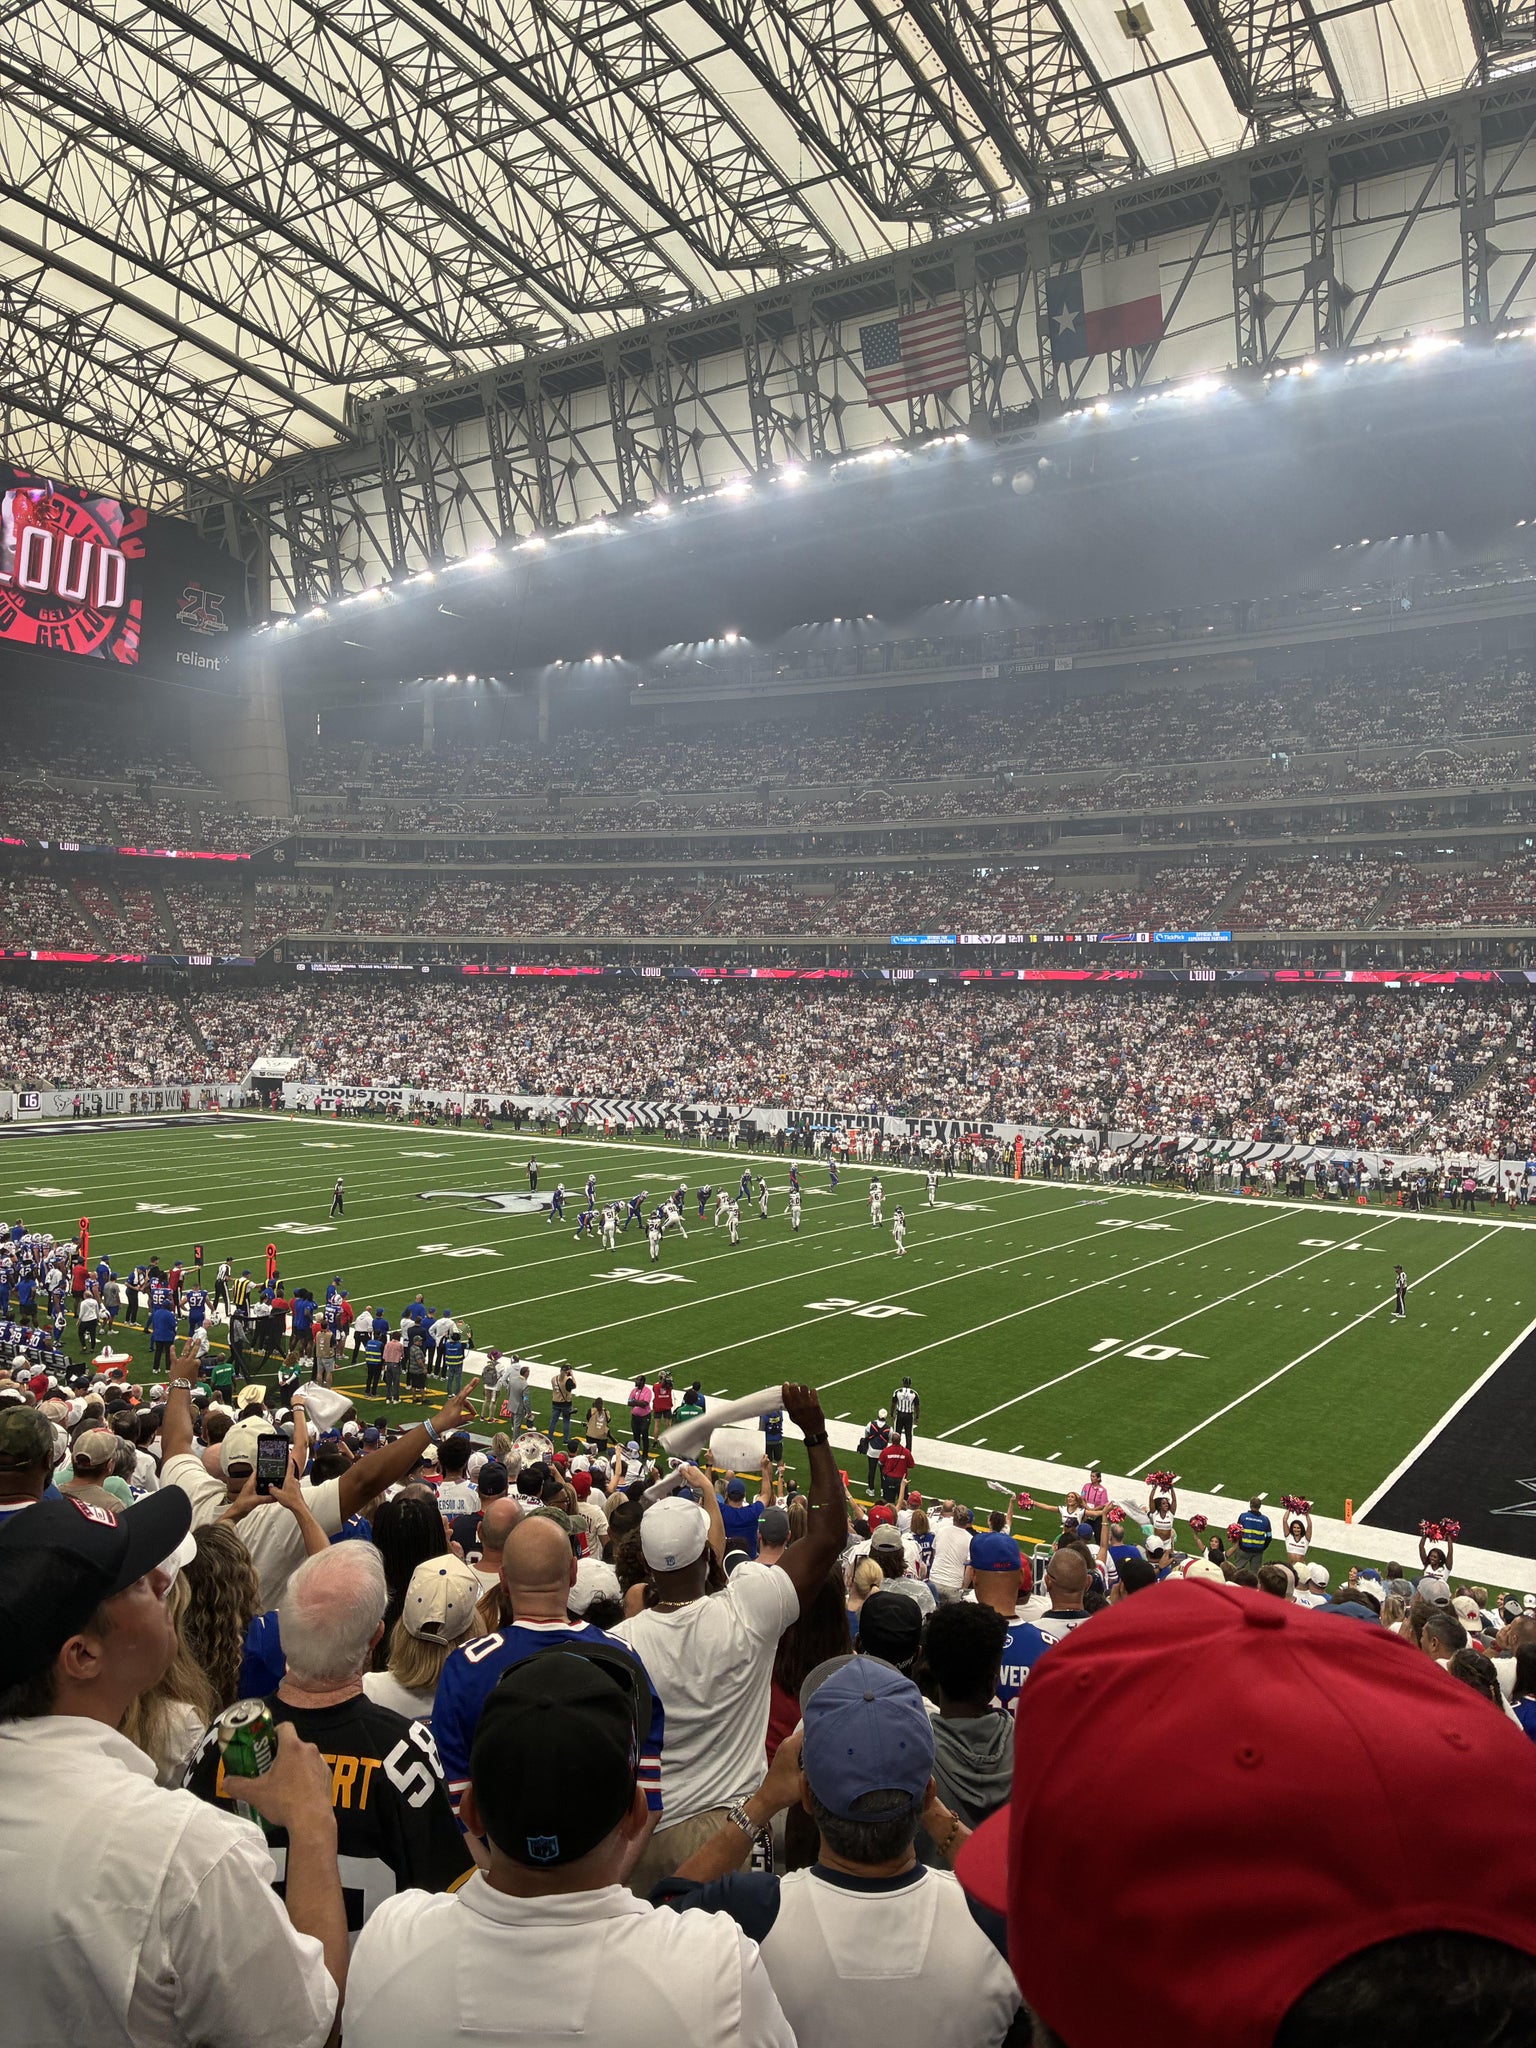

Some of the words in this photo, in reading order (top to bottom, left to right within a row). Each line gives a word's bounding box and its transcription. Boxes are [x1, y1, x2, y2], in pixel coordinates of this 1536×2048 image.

[0, 526, 126, 610] OUD
[36, 623, 75, 652] GET
[176, 651, 220, 671] reliant
[59, 842, 79, 851] LOUD
[1008, 935, 1024, 943] 12:11
[1029, 935, 1037, 943] 16
[1086, 934, 1098, 942] 1ST
[1140, 933, 1146, 941] 0
[189, 956, 212, 966] LOUD
[642, 967, 661, 977] LOUD
[892, 969, 914, 979] LOUD
[1189, 970, 1216, 981] LOUD
[25, 1091, 38, 1108] 16
[320, 1088, 403, 1100] HOUSTON
[105, 1091, 124, 1110] UP
[905, 1118, 994, 1144] TEXANS
[259, 1222, 338, 1235] 50
[195, 1245, 202, 1259] 3
[415, 1243, 498, 1258] 40
[19, 1267, 32, 1277] 42
[590, 1267, 686, 1285] 30
[152, 1294, 165, 1305] 96
[189, 1295, 204, 1307] 97
[803, 1297, 909, 1319] 20
[1088, 1337, 1184, 1361] 10
[457, 1499, 465, 1510] JR
[382, 1720, 445, 1809] 58
